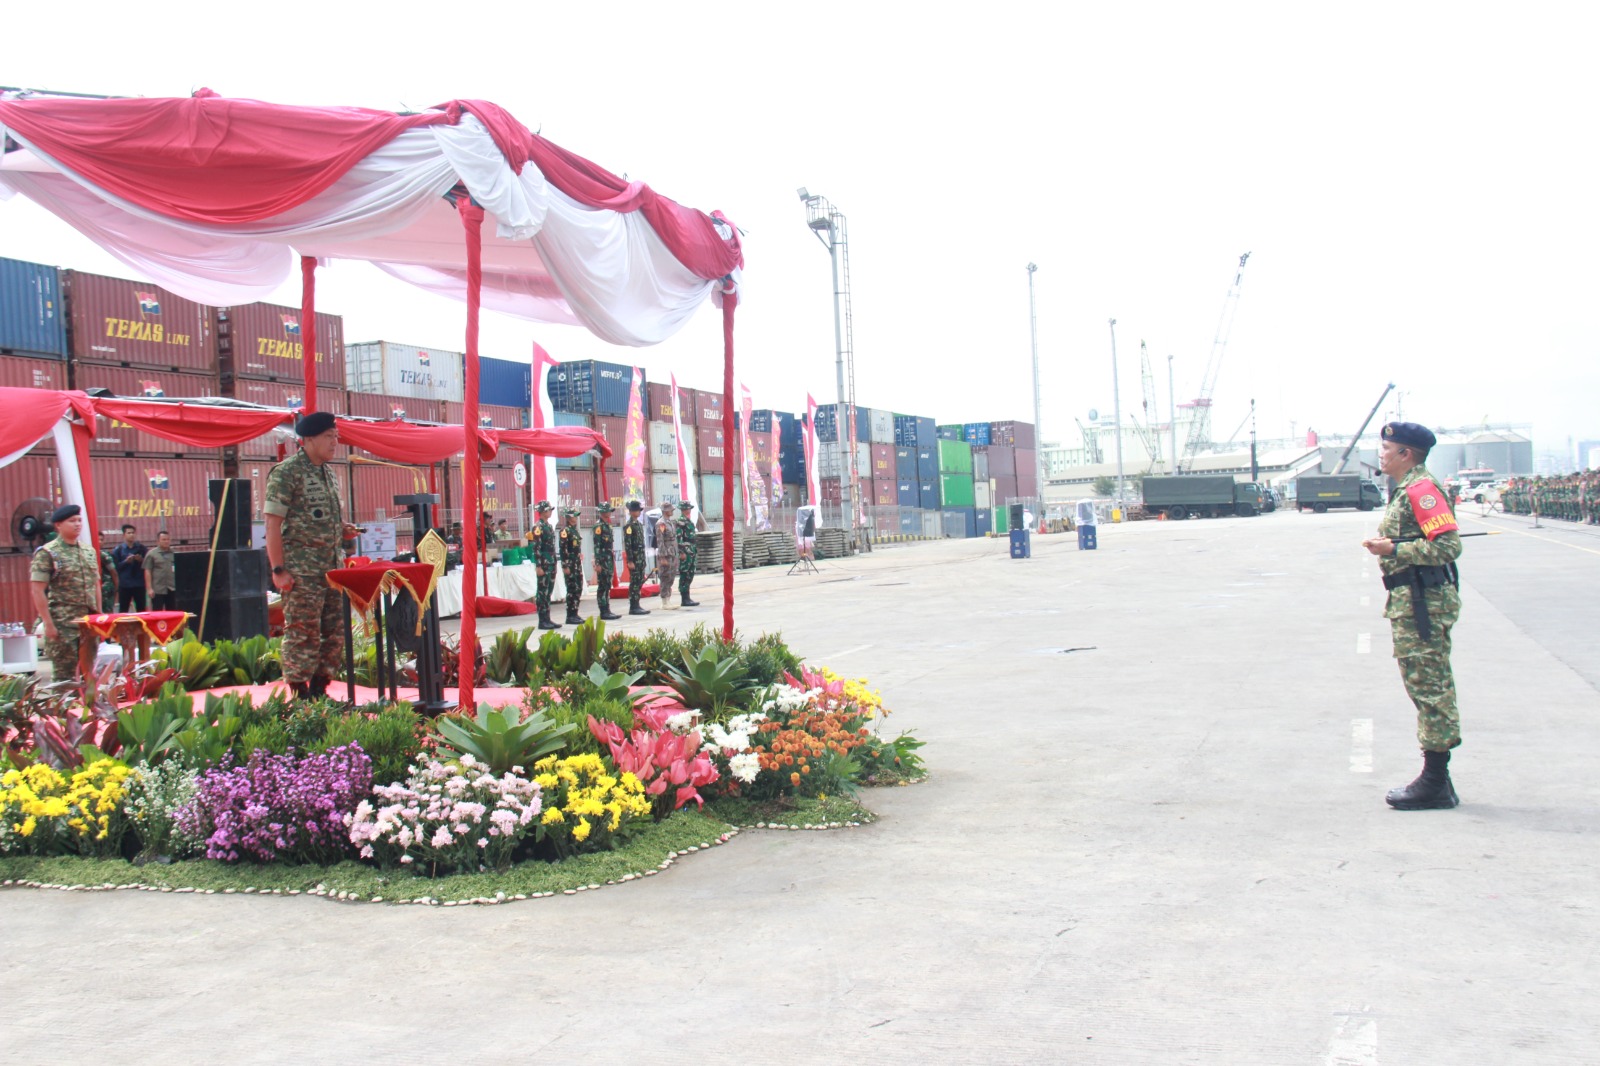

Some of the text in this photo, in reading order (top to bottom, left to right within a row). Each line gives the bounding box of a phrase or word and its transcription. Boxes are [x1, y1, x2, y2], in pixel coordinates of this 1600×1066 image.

[105, 317, 191, 346] TEMAS LINE
[258, 337, 303, 360] TEMAS
[116, 499, 200, 518] TEMAS LINE
